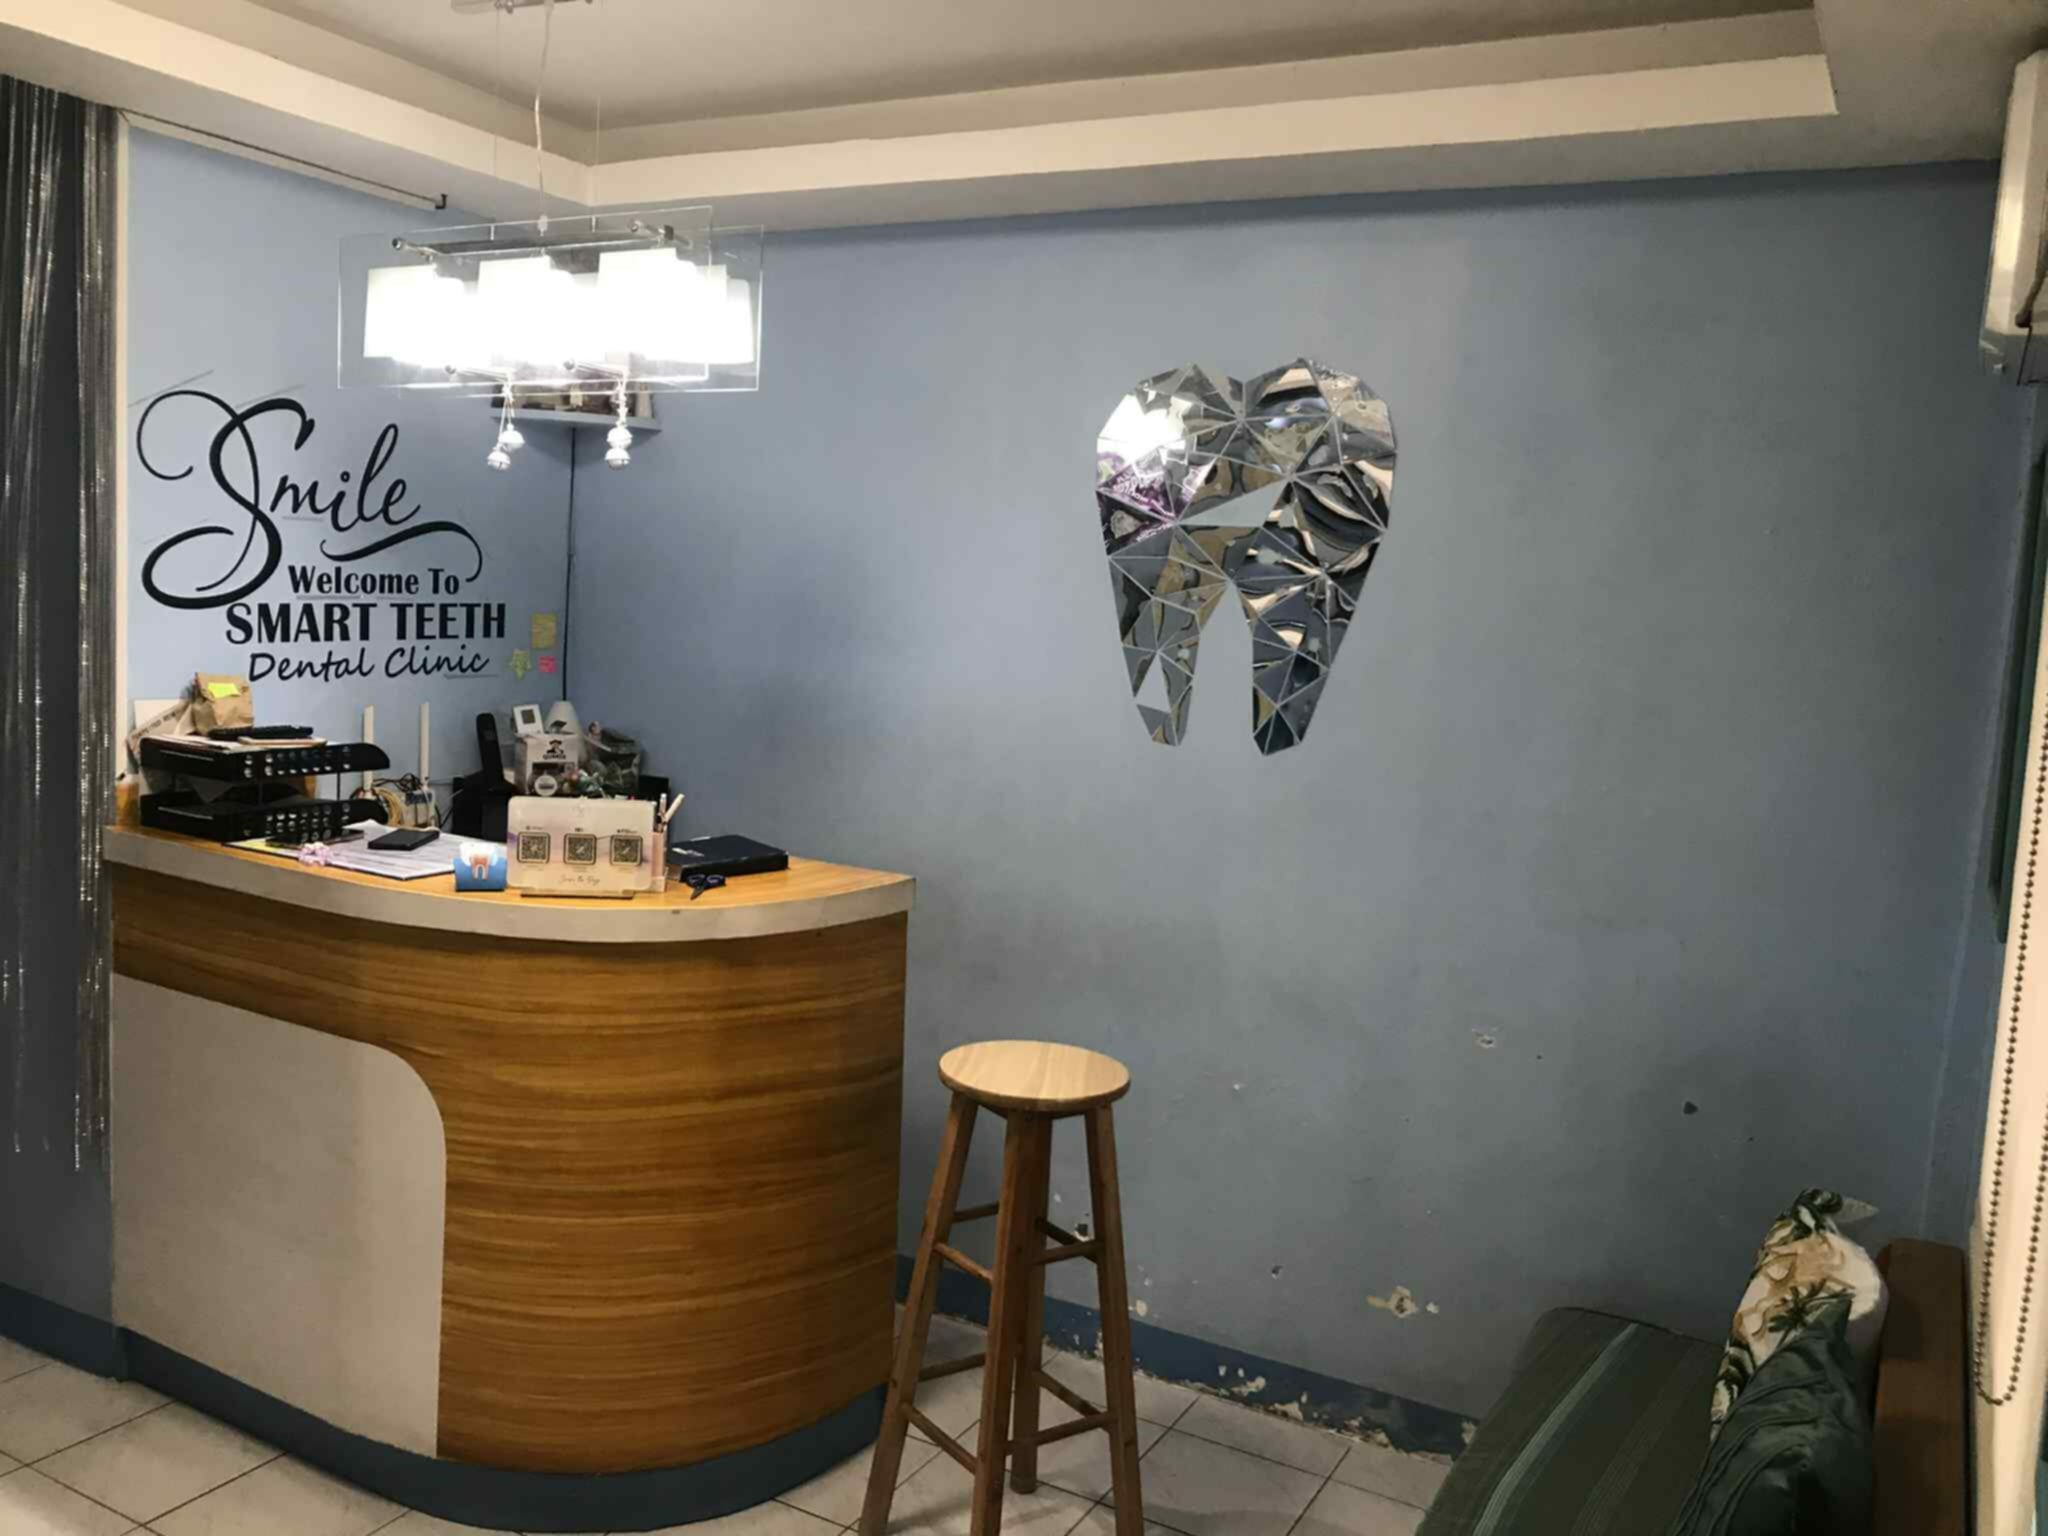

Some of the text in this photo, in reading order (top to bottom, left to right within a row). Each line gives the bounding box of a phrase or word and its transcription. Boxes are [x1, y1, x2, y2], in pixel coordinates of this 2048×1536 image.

[137, 390, 421, 610] Smile
[288, 565, 460, 595] Welcome To
[226, 602, 378, 645] SMART
[389, 602, 507, 641] TEETH
[249, 645, 490, 683] Dental Clinic
